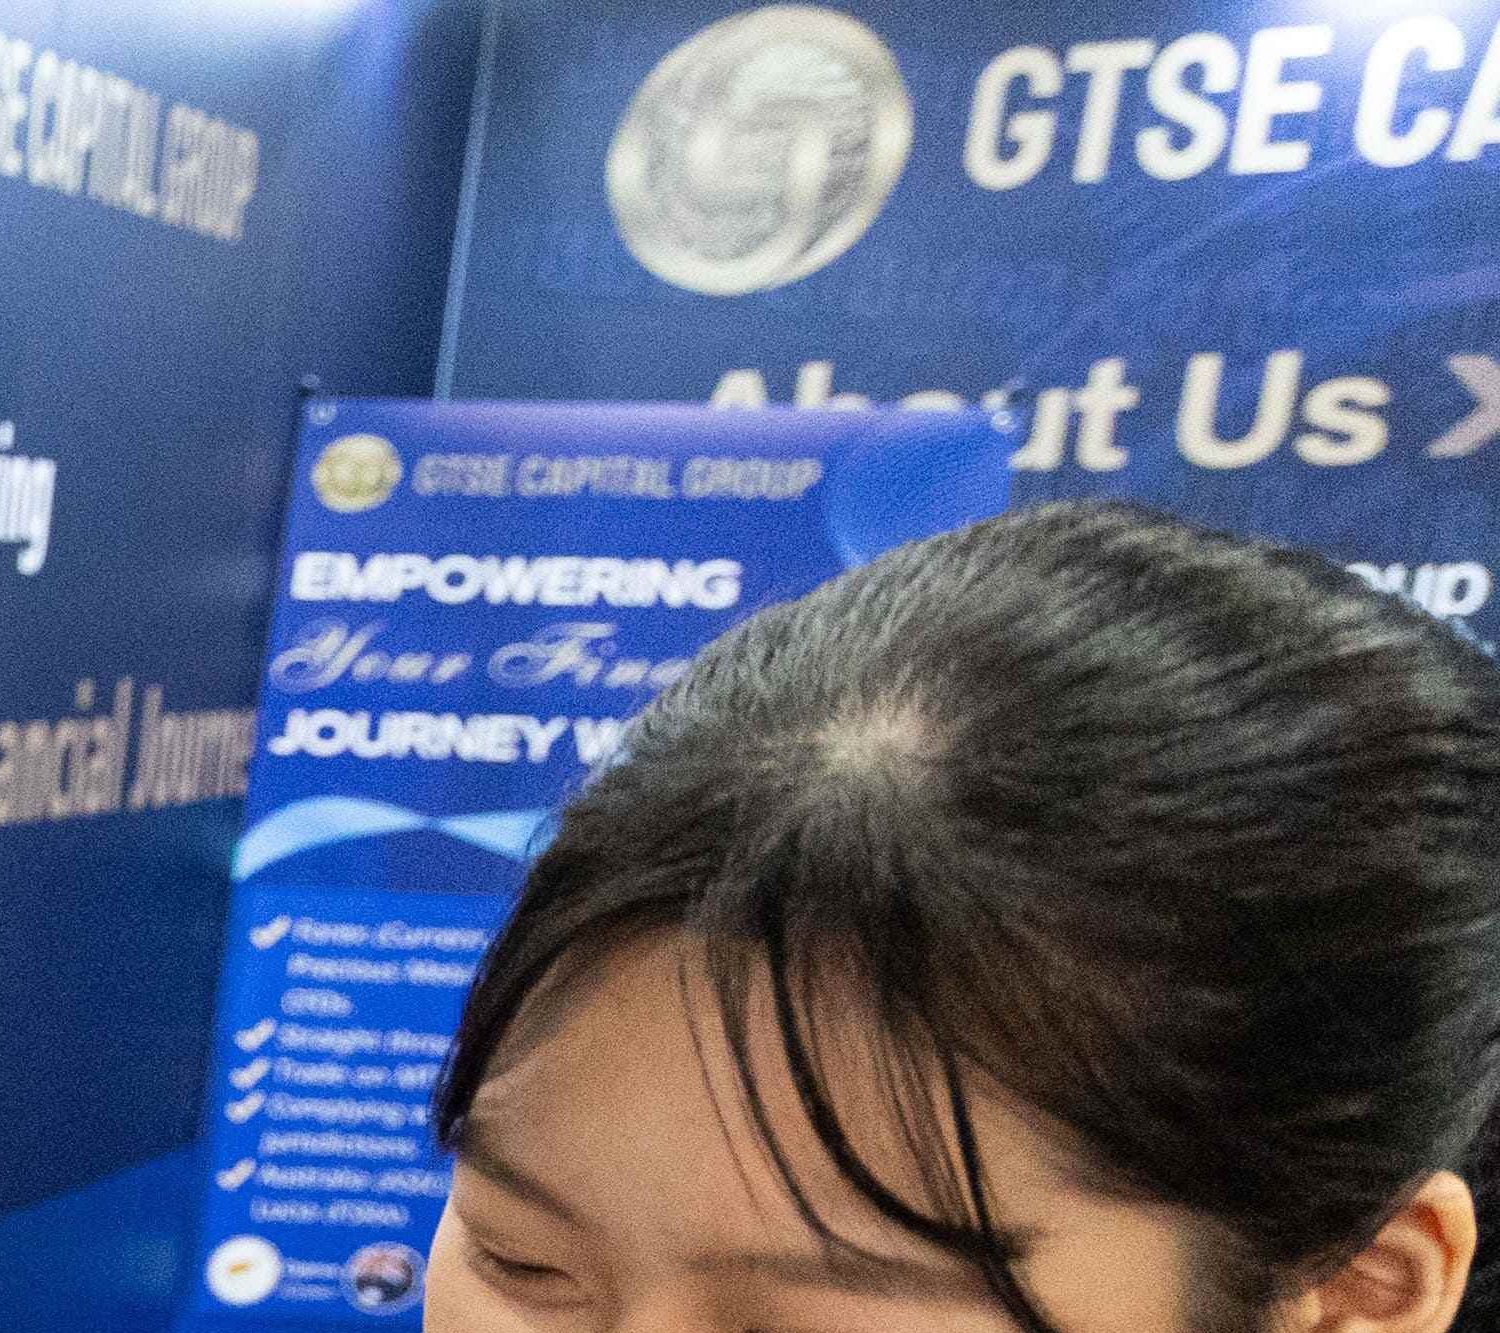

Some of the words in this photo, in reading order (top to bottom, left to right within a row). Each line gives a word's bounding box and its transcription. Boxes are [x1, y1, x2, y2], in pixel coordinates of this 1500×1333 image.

[28, 50, 160, 220] CAPITAL
[160, 103, 262, 242] GROUP
[964, 25, 1332, 191] GTSE
[1176, 350, 1392, 470] Us
[291, 550, 742, 611] EMPOWERING
[269, 616, 472, 694] Your
[267, 707, 566, 764] JOURNEY
